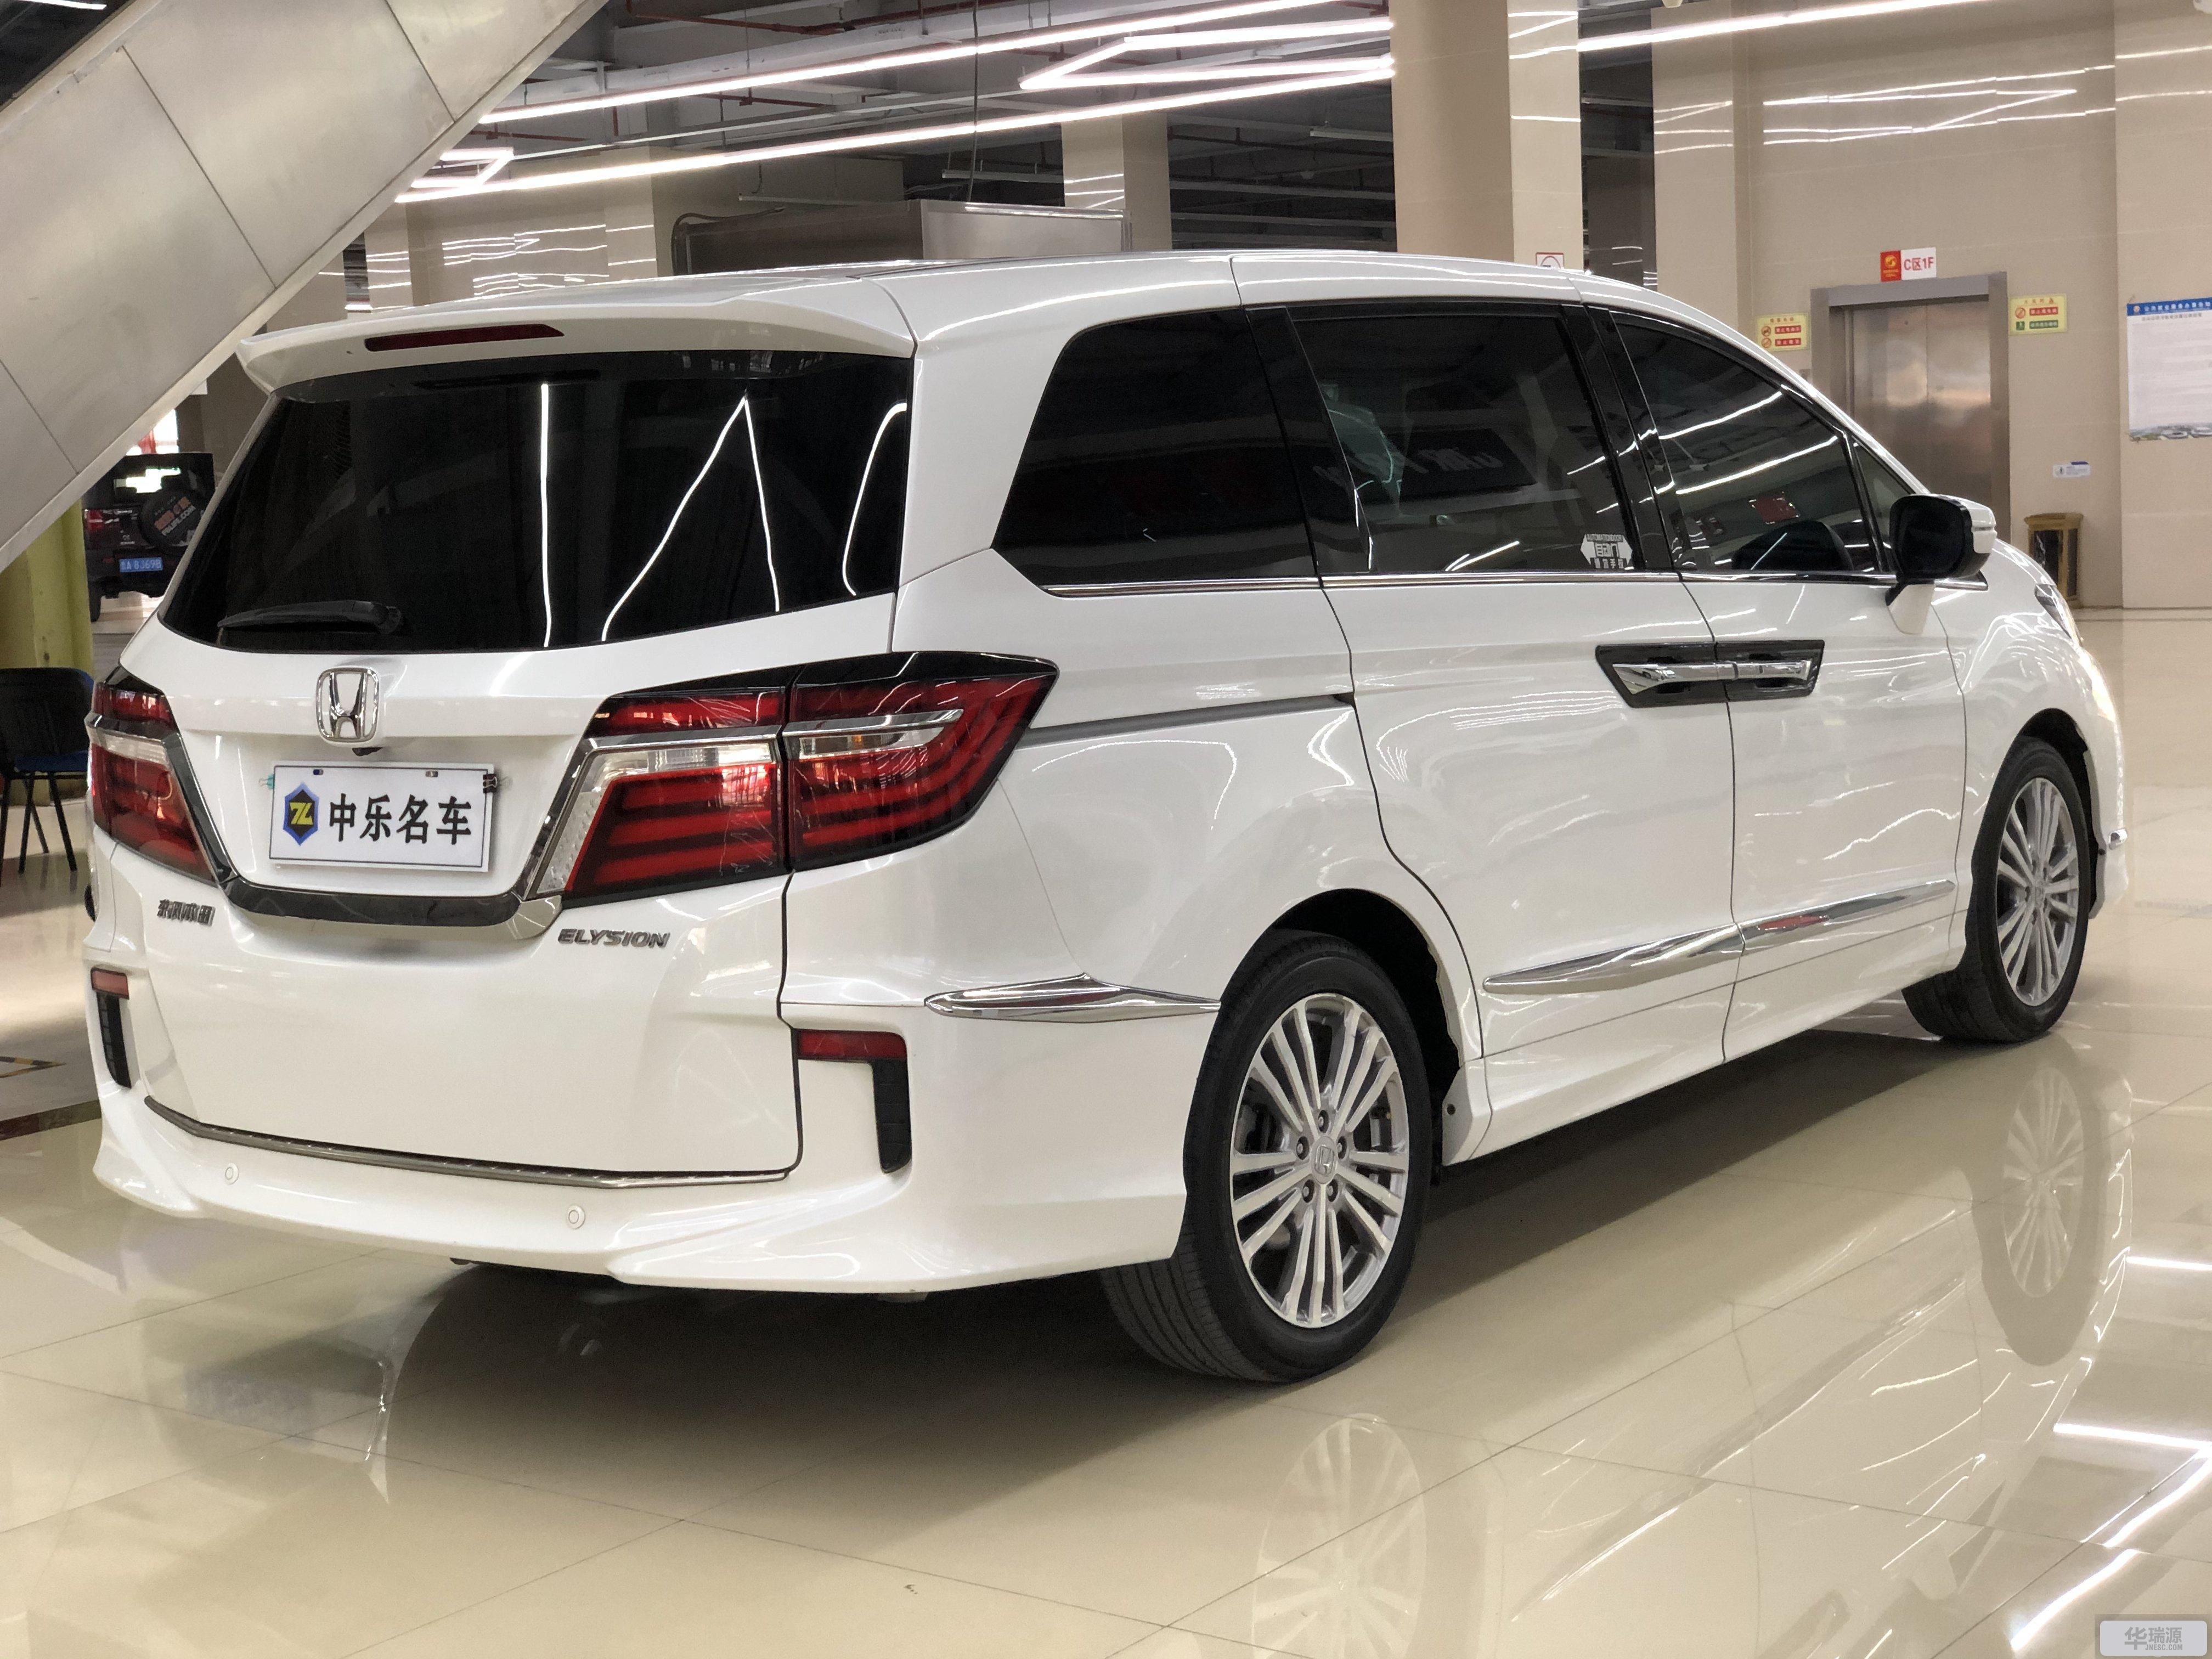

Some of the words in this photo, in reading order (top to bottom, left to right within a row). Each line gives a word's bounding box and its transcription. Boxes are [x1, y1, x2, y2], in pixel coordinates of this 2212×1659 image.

[1904, 256, 1934, 271] C区1F
[329, 792, 472, 845] 中乐名车
[557, 928, 671, 949] ELYSION
